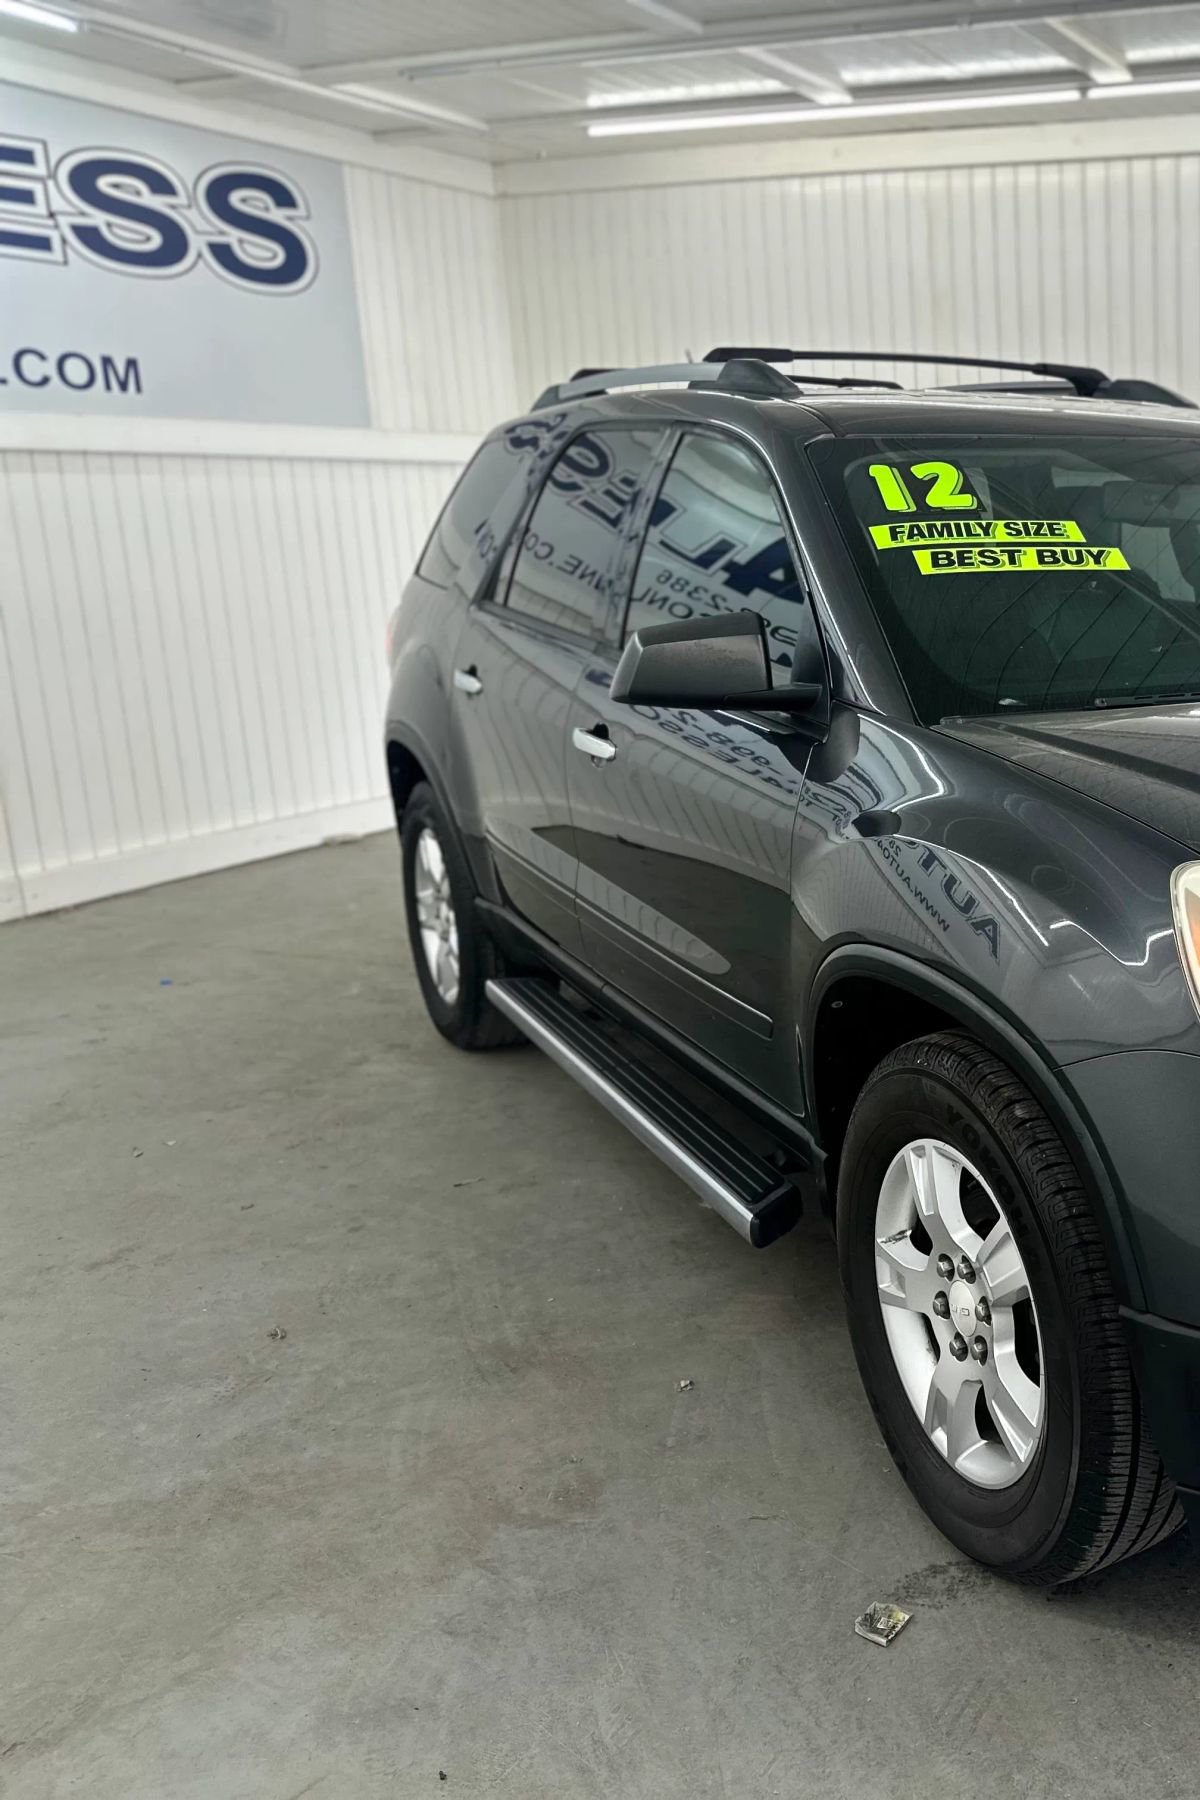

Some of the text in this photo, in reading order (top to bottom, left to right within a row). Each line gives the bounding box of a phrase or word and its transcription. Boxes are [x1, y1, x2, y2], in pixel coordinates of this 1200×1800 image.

[868, 461, 978, 512] 12
[889, 521, 1070, 543] FAMILY SIZE
[930, 548, 1111, 570] BEST BUY
